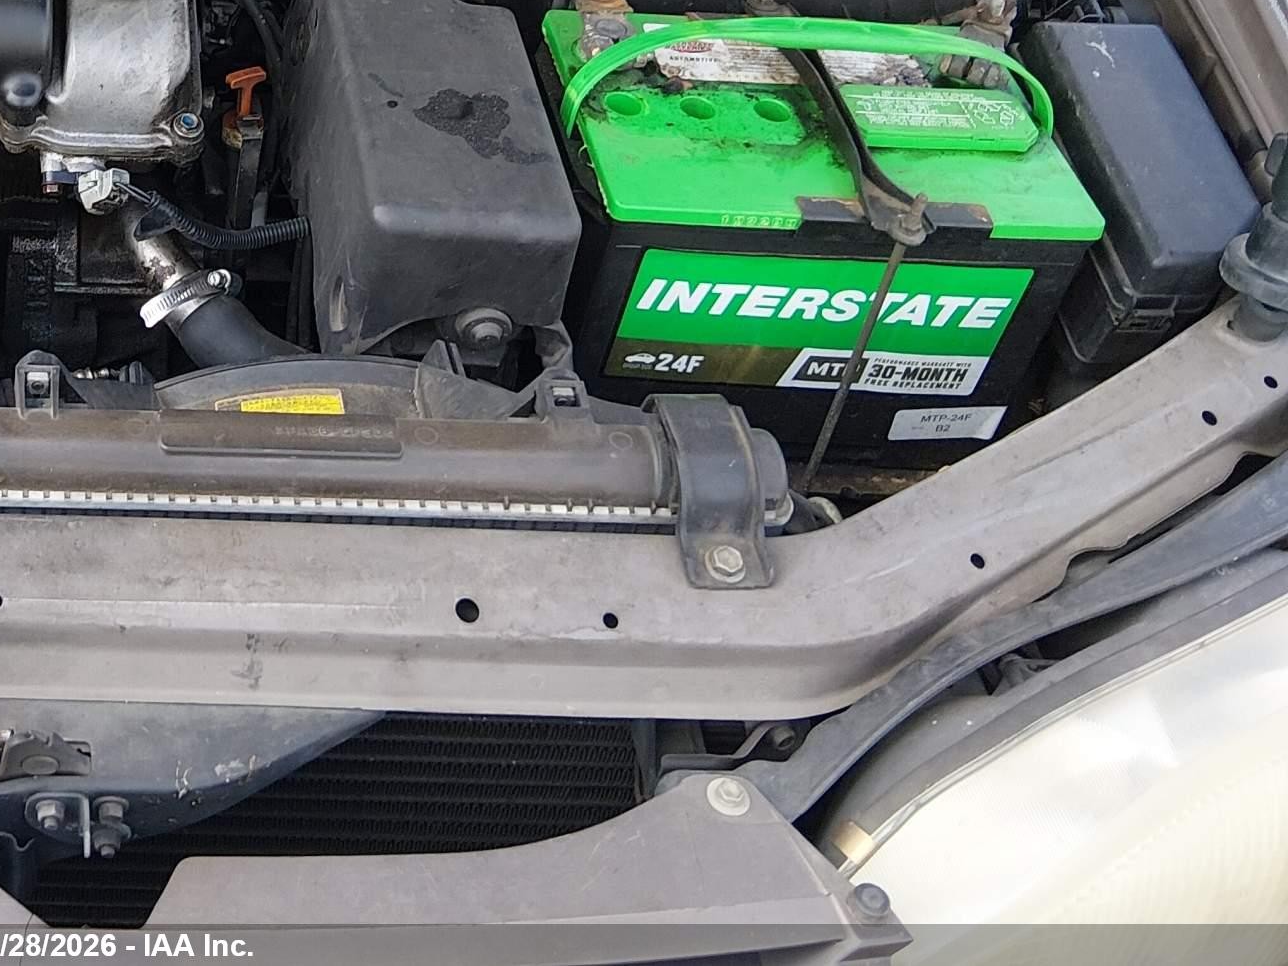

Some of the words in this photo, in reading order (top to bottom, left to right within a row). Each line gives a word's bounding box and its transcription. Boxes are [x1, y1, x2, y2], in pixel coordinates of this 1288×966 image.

[636, 278, 1012, 330] INTERSTATE
[654, 353, 705, 374] 24F
[867, 363, 969, 383] 30-MONTH
[864, 377, 889, 387] FREE
[892, 380, 962, 390] REPLACEMENT
[920, 414, 973, 423] MTP-24F
